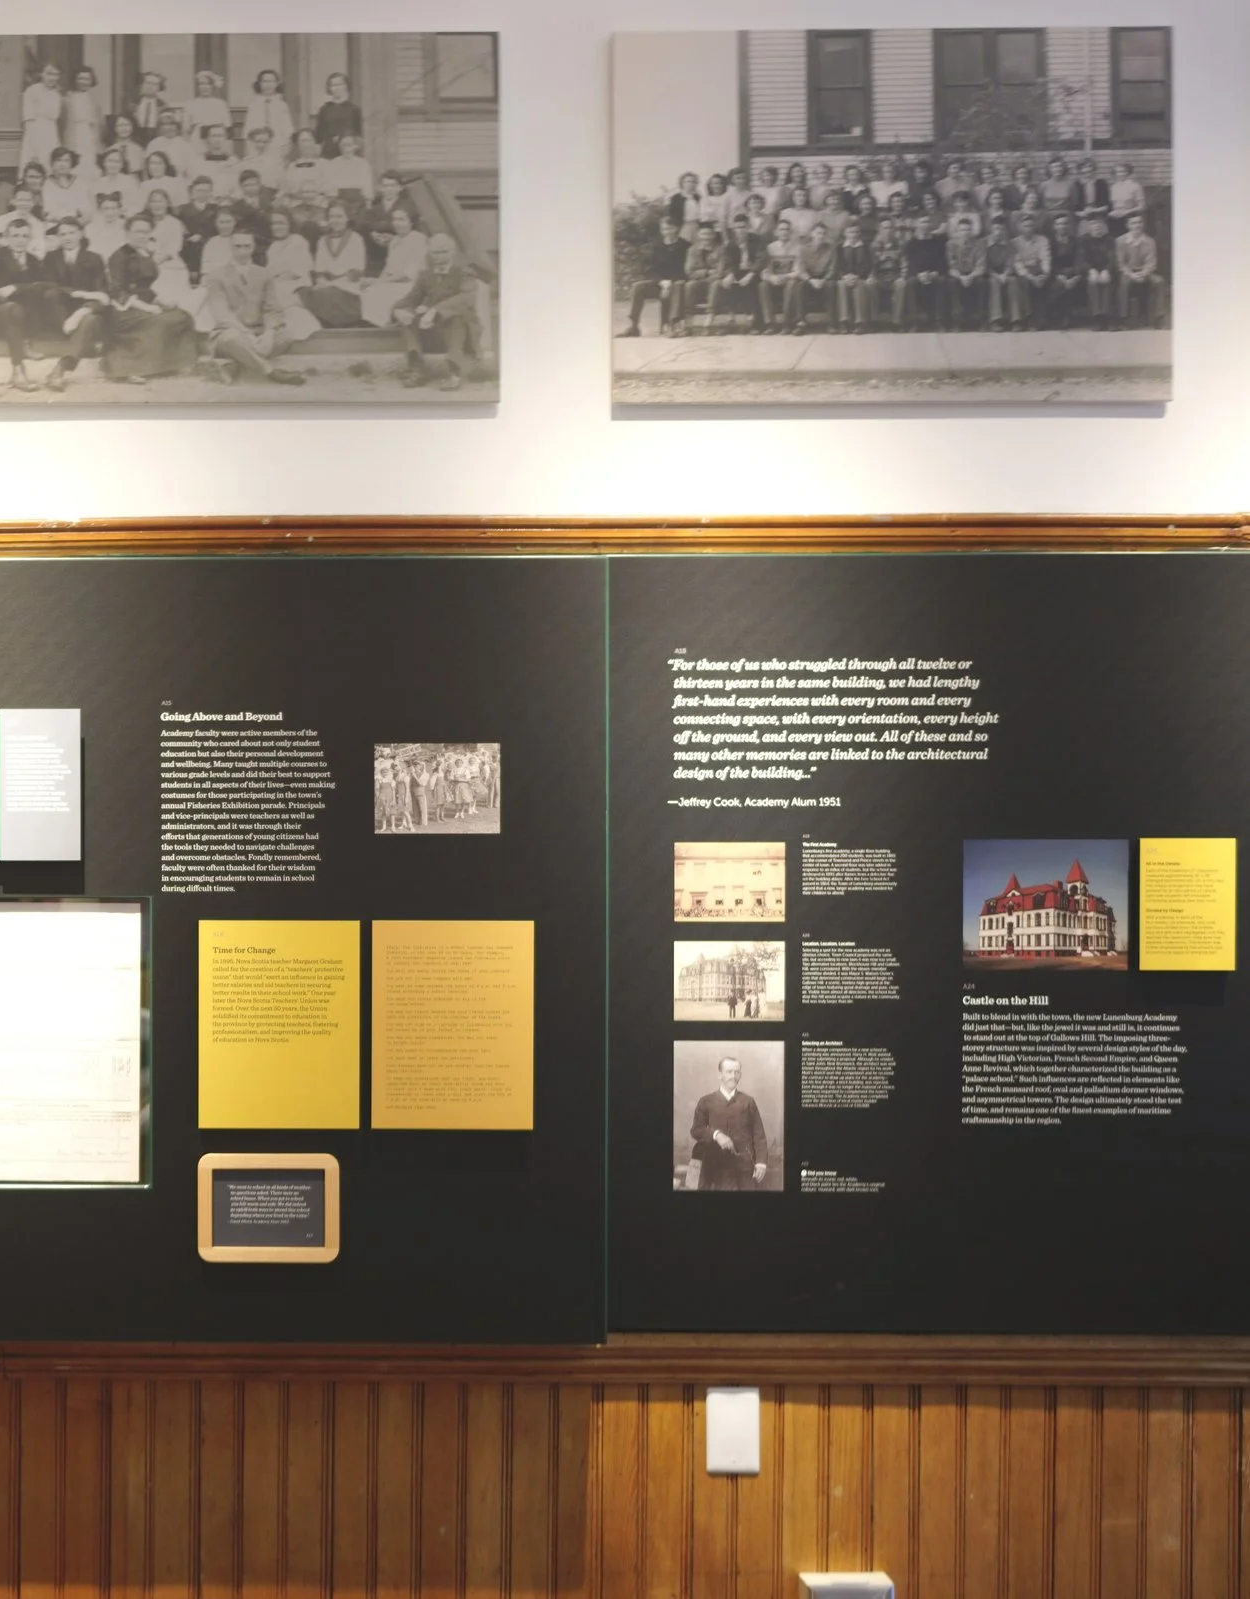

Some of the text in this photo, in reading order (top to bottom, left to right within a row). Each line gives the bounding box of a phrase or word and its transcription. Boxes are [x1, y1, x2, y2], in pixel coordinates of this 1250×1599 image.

[696, 658, 730, 671] those
[730, 658, 744, 673] of
[744, 661, 760, 670] us
[761, 658, 788, 671] who
[787, 658, 847, 672] struggled
[847, 658, 897, 672] through
[898, 658, 916, 670] all
[916, 658, 957, 670] twelve
[957, 661, 973, 670] or
[673, 676, 980, 691] thirteen years in the same building, we had lengthy
[671, 694, 972, 709] first-hand experiences with every room and every
[160, 712, 283, 722] Going Above and Beyond
[673, 712, 999, 727] connecting space, with every orientation, every height
[160, 729, 194, 738] Academy
[195, 729, 220, 738] faculty
[673, 730, 988, 745] off the ground, and every view out. All of these and so
[673, 748, 989, 763] many other memories are linked to the architectural
[673, 766, 714, 781] design
[715, 766, 731, 781] of
[729, 766, 750, 779] the
[713, 797, 742, 807] Cook,
[744, 797, 790, 809] Academy
[791, 797, 817, 807] Alum
[819, 796, 841, 807] 1951
[212, 946, 276, 955] Time for Change
[962, 995, 995, 1005] Castle
[1010, 995, 1028, 1005] the
[1029, 995, 1049, 1005] Hill
